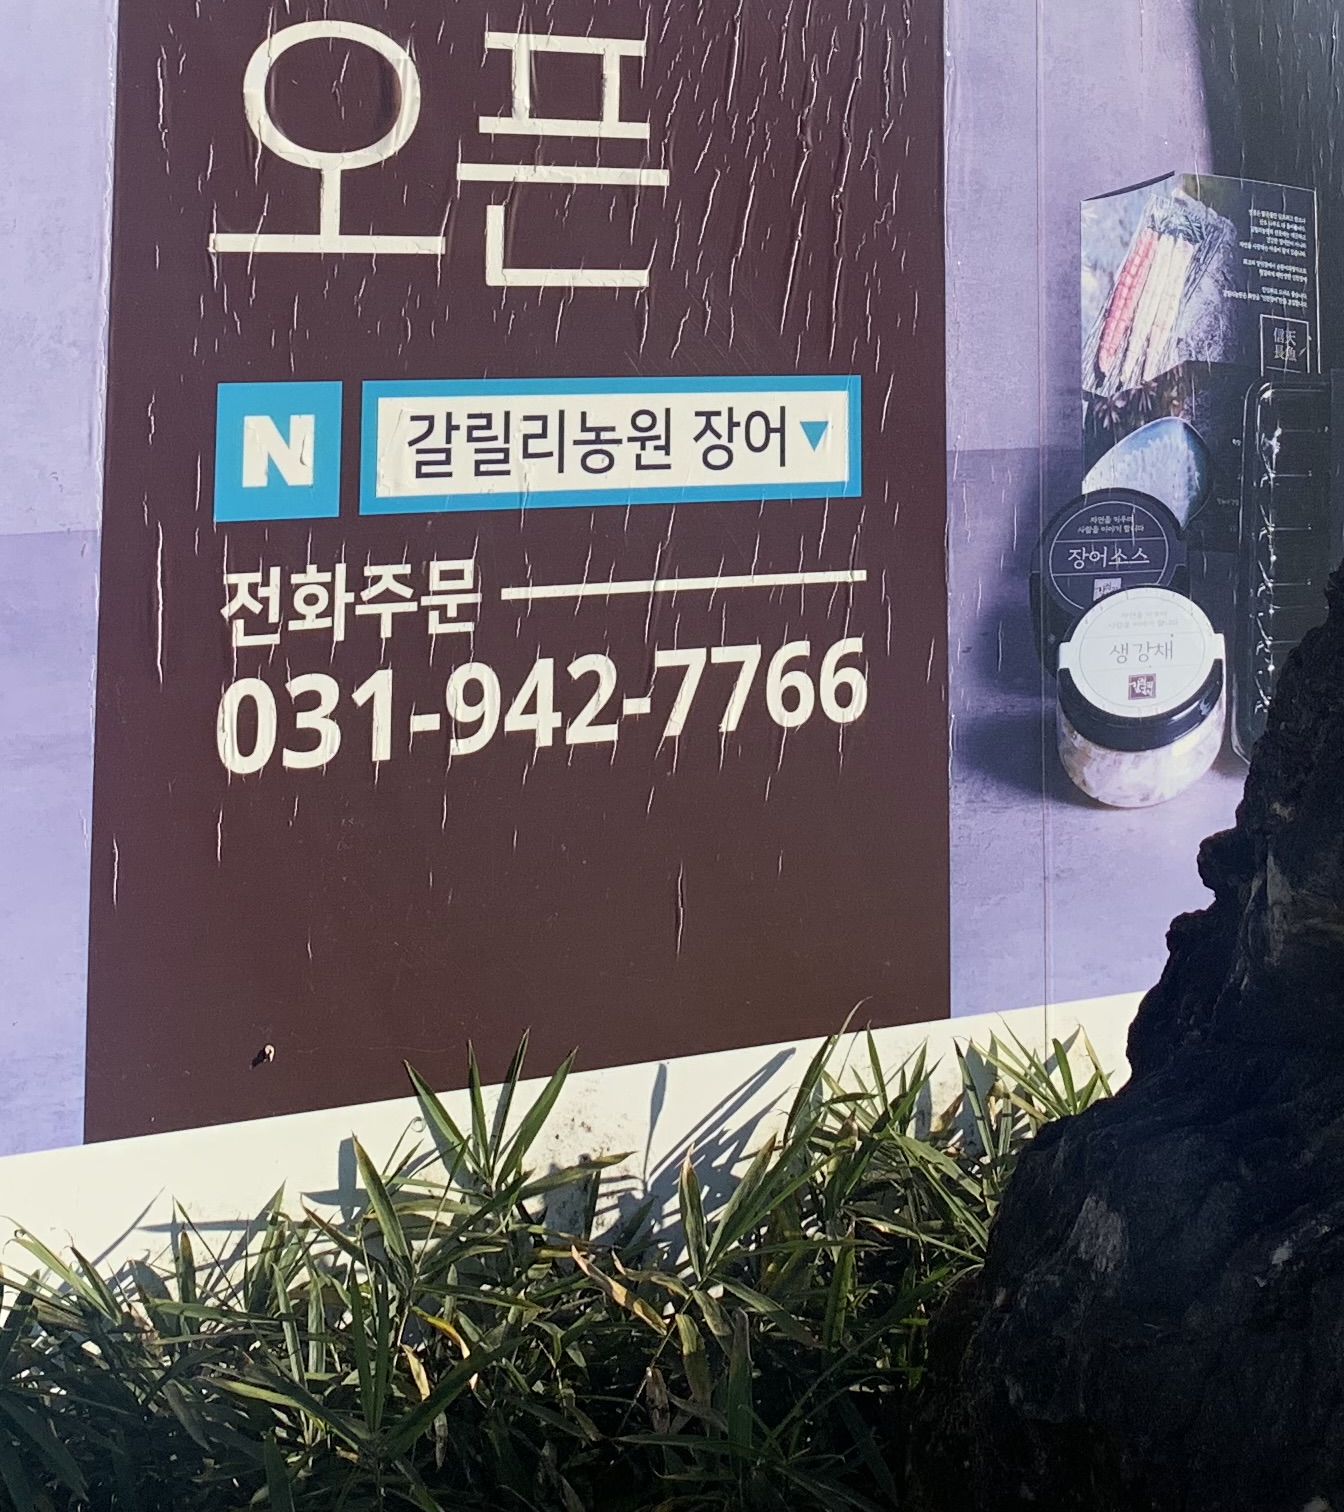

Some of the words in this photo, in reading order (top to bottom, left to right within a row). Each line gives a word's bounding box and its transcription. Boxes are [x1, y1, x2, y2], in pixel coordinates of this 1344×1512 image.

[208, 19, 670, 287] 오픈
[241, 414, 315, 487] N
[405, 406, 673, 480] 갈릴리농원
[692, 405, 788, 471] 장어
[1067, 545, 1150, 570] 장어소스
[220, 558, 482, 648] 전화주문
[216, 637, 868, 775] 031-942-7766
